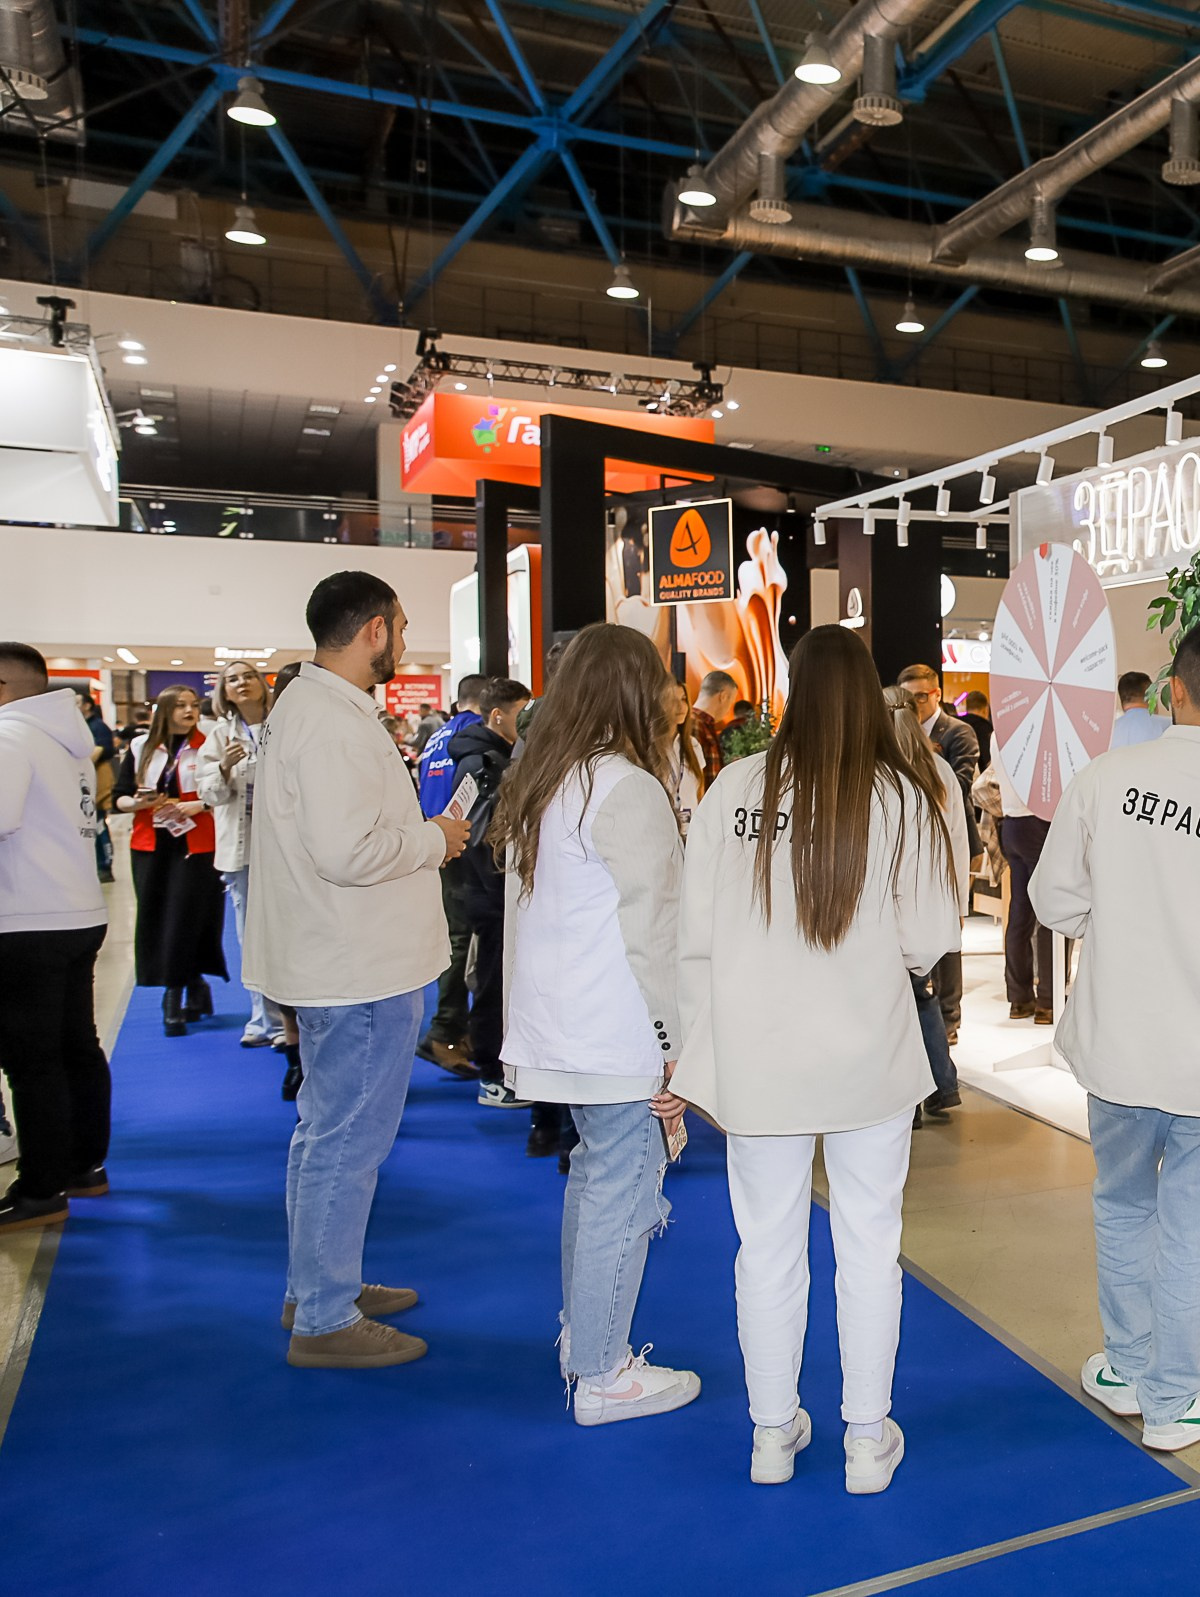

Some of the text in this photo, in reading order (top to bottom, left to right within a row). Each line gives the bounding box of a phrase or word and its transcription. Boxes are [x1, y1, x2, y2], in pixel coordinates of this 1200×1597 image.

[659, 570, 725, 589] ALMAFOOD
[659, 586, 724, 600] QUALITY BRANDS
[734, 807, 791, 843] ЗДР
